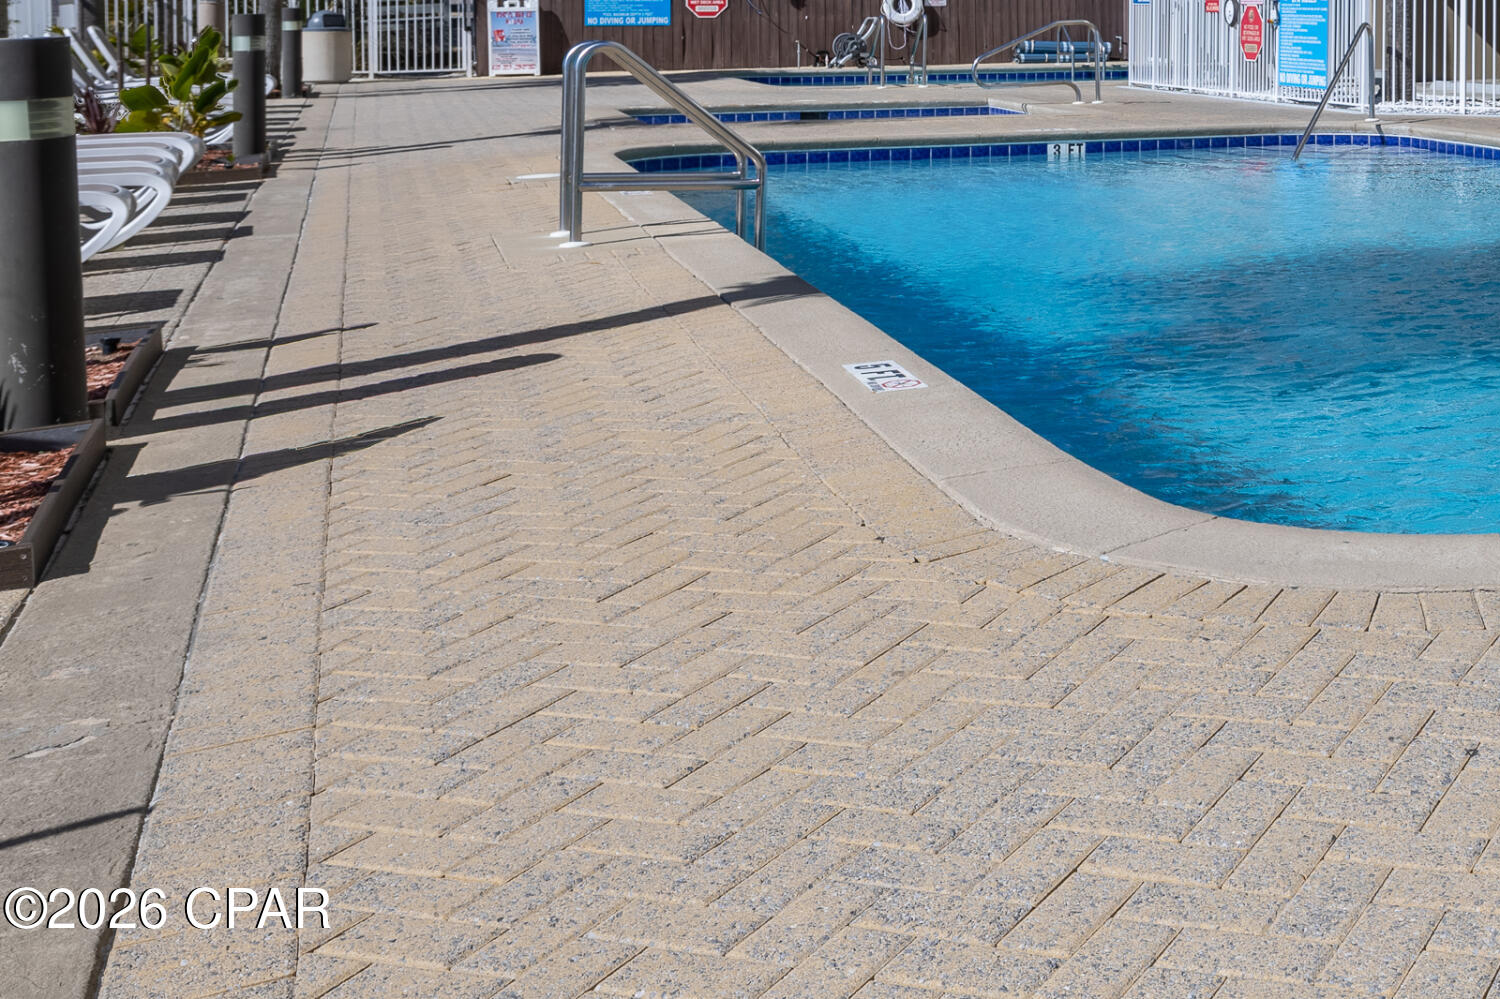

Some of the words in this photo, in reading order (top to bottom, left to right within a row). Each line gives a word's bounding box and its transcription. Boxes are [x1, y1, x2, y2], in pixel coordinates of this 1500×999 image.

[1053, 144, 1061, 158] 3
[1069, 143, 1083, 158] FT
[860, 370, 906, 380] FT
